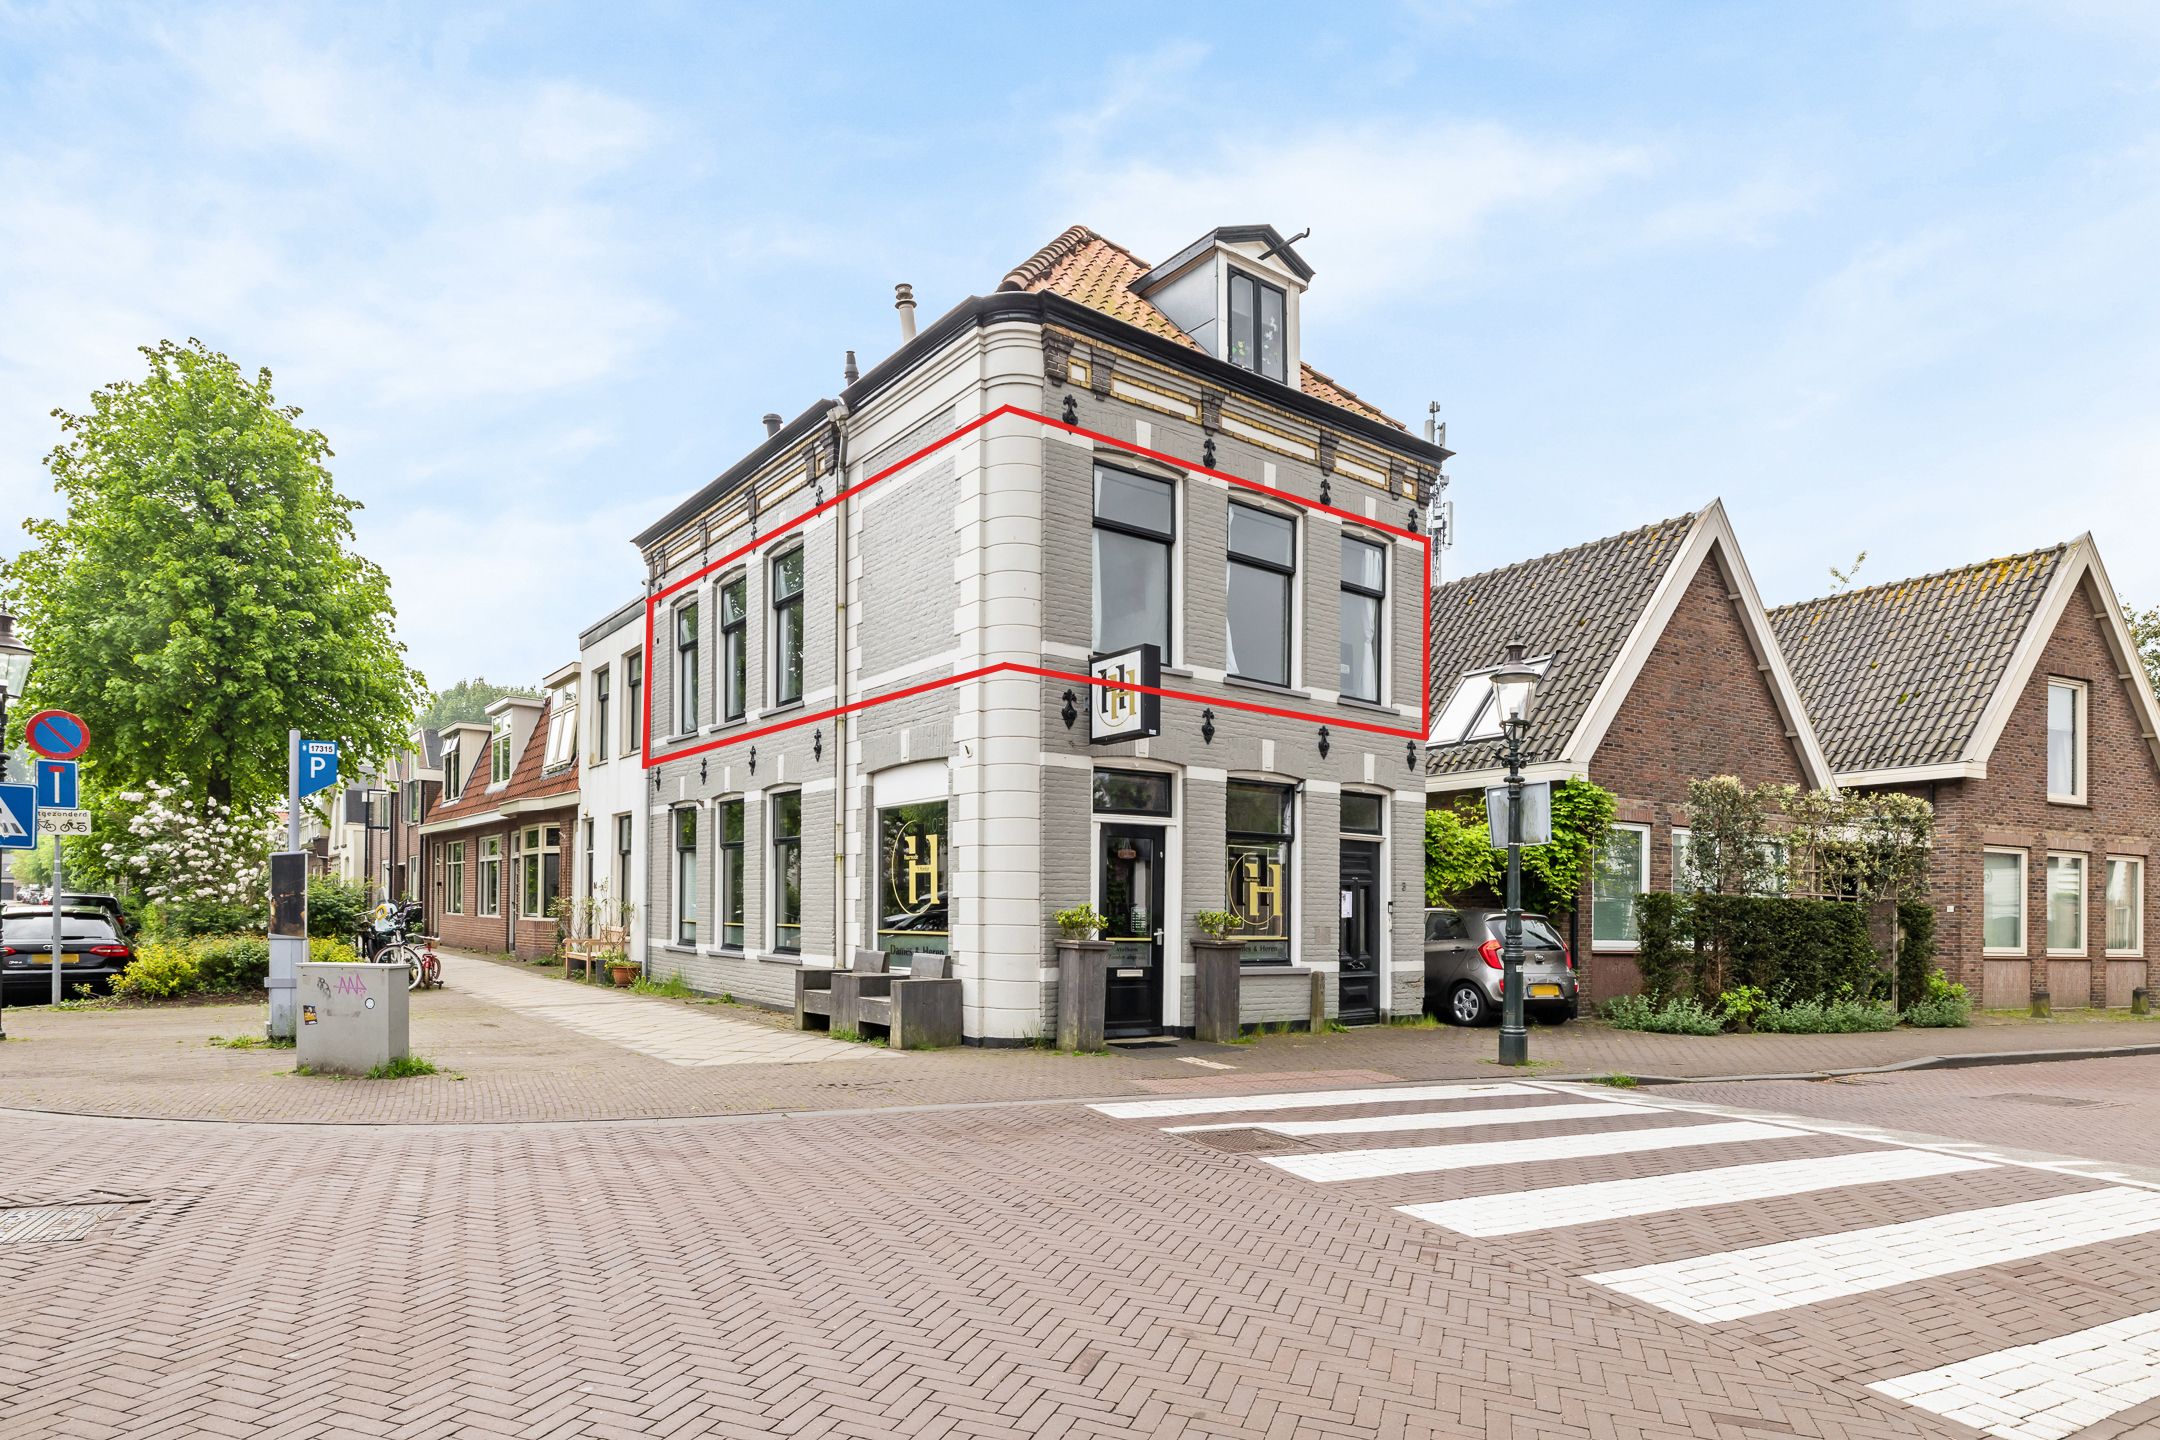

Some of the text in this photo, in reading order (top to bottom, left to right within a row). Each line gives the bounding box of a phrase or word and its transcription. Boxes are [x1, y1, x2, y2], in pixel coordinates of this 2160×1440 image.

[310, 745, 333, 753] 17315
[310, 756, 326, 779] P
[37, 810, 88, 818] tgezonderd
[890, 944, 913, 956] Dames
[1260, 944, 1278, 953] Heren
